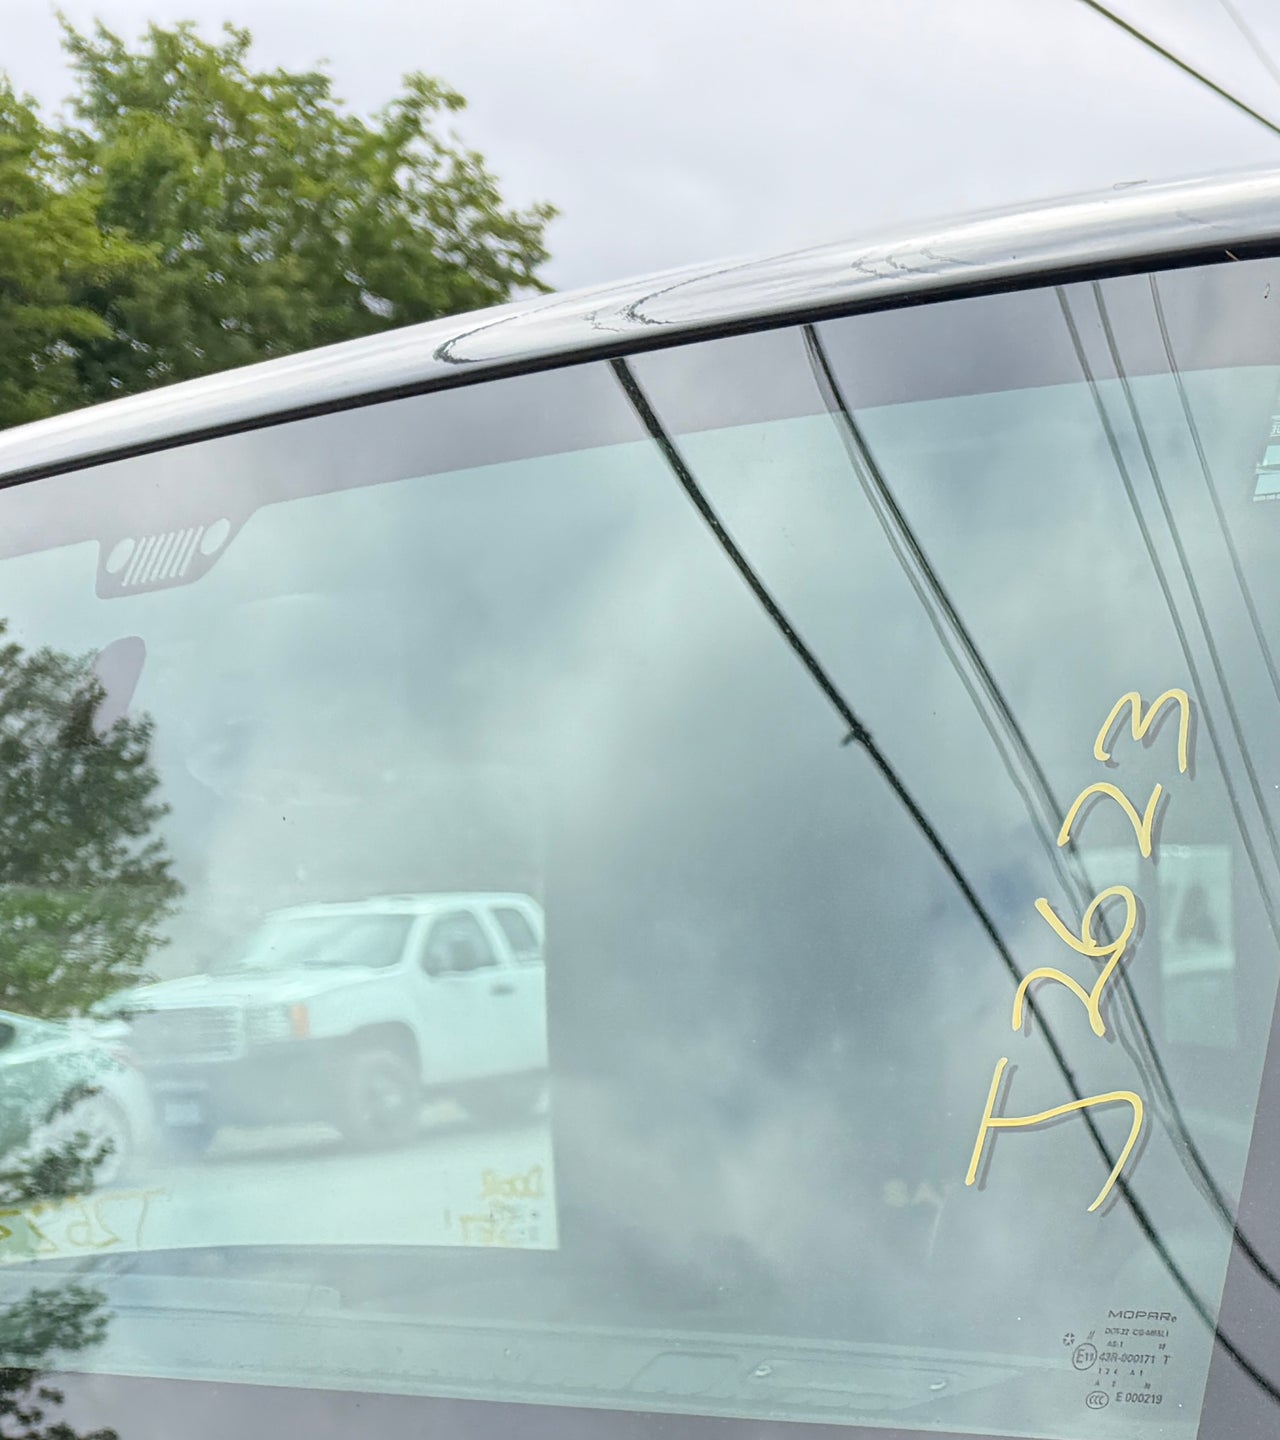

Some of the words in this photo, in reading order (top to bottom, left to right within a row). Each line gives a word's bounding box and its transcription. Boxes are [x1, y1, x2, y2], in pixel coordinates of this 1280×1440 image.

[964, 688, 1190, 1212] J2623
[1108, 1310, 1172, 1321] MOPAR
[1125, 1393, 1163, 1404] 000219
